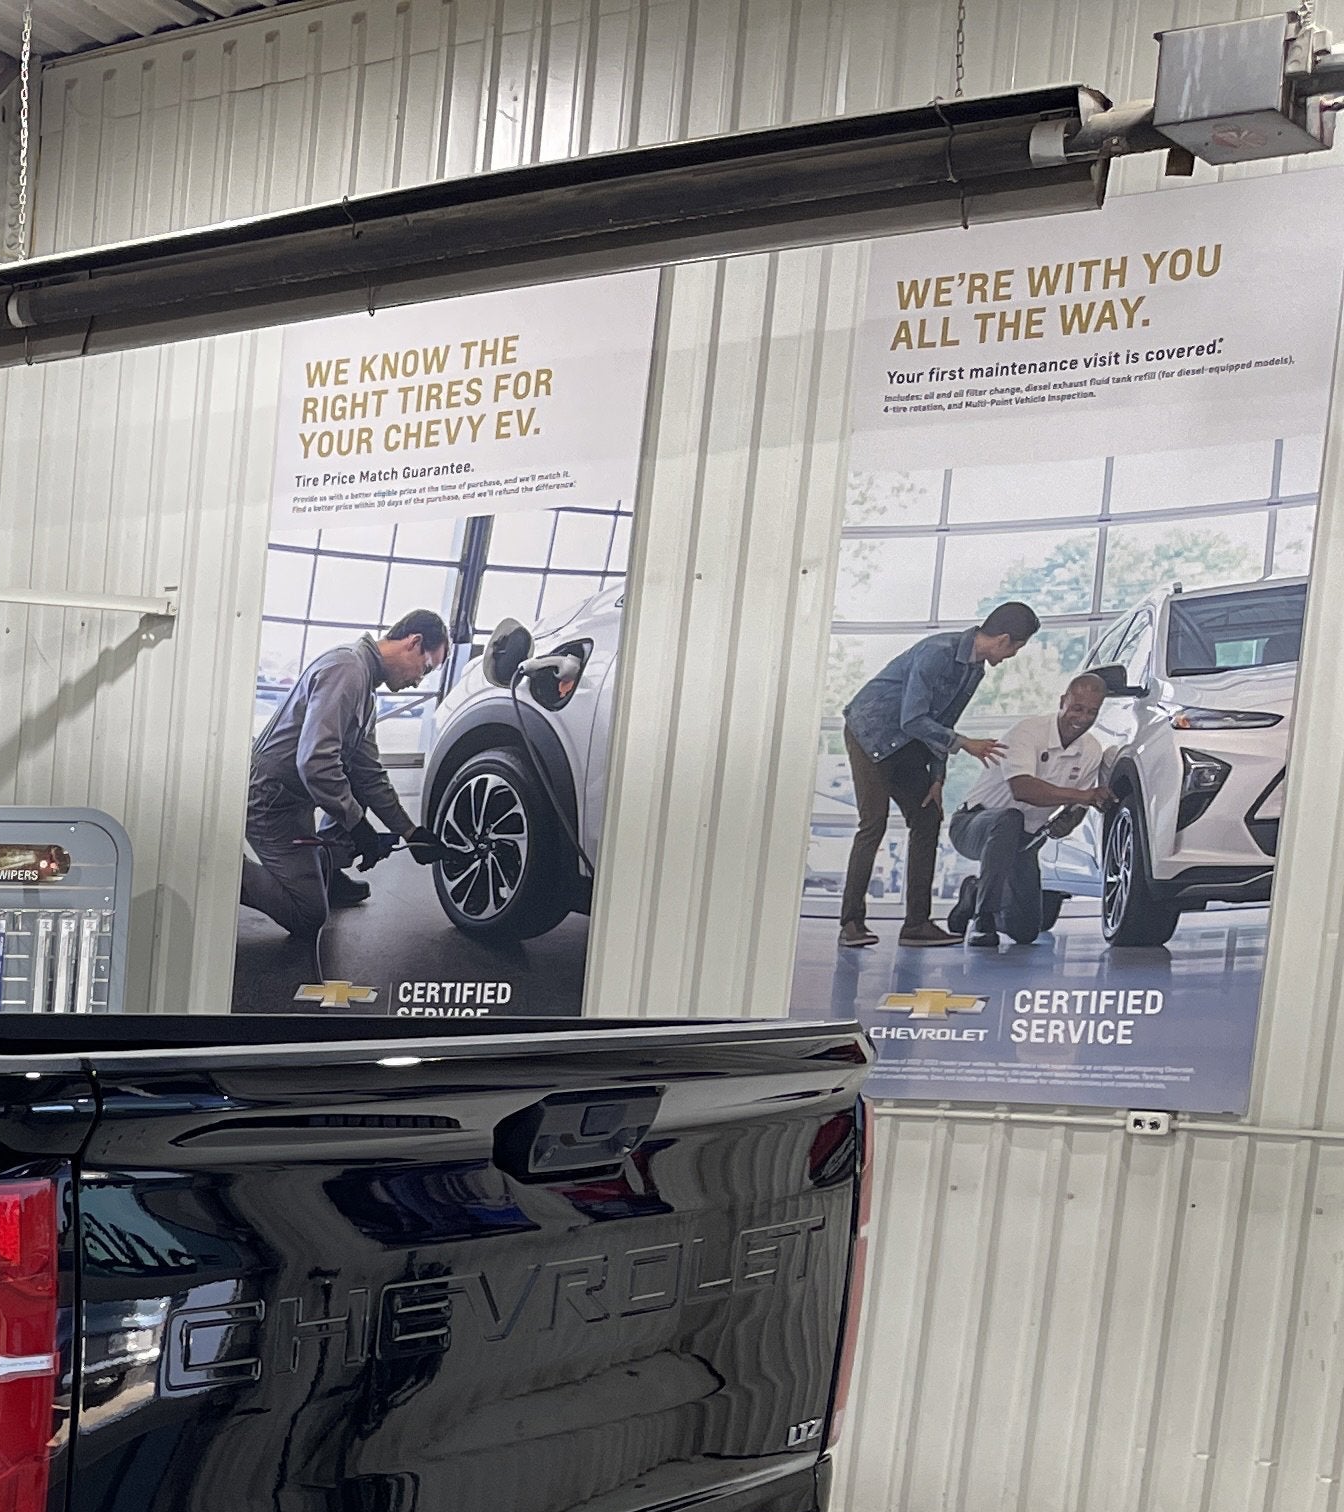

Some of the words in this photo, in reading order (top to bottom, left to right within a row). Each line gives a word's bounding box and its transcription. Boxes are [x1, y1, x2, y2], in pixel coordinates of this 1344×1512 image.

[1027, 256, 1127, 298] WITH
[1142, 244, 1222, 285] YOU
[890, 317, 960, 351] ALL
[974, 307, 1047, 343] THE
[1060, 296, 1151, 336] WAY.
[305, 358, 351, 388] WE
[359, 344, 451, 383] KNOW
[460, 335, 519, 370] THE
[887, 371, 924, 384] Your
[929, 367, 964, 382] first
[969, 357, 1078, 379] maintenance
[1084, 352, 1120, 368] visit
[1126, 351, 1139, 364] is
[937, 391, 952, 399] and
[989, 385, 1024, 396] change,
[1025, 382, 1051, 392] diesel
[1053, 379, 1088, 390] exhaust
[1090, 376, 1110, 386] fluid
[1112, 374, 1132, 383] tank
[1134, 372, 1156, 382] refill
[1158, 369, 1175, 380] (for
[1177, 360, 1253, 377] diesel-equipped
[301, 389, 389, 424] RIGHT
[398, 377, 483, 415] TIRES
[493, 368, 553, 403] FOR
[909, 402, 945, 413] rotation,
[947, 401, 963, 410] and
[965, 397, 1013, 409] Multi-Point
[1015, 395, 1045, 405] Vehicle
[298, 427, 374, 459] YOUR
[383, 413, 487, 451] CHEVY
[495, 407, 541, 440] EV.
[295, 475, 319, 488] Tire
[323, 473, 356, 486] Price
[359, 467, 398, 483] Match
[402, 462, 475, 480] Guarantee.
[328, 493, 344, 501] with
[350, 492, 372, 500] better
[399, 487, 416, 496] price
[440, 483, 457, 492] time
[458, 481, 466, 490] of
[503, 475, 518, 485] and
[537, 471, 561, 481] match
[313, 503, 334, 512] better
[335, 502, 353, 512] price
[387, 498, 403, 507] days
[413, 496, 425, 504] the
[462, 492, 475, 500] and
[494, 487, 520, 497] refund
[521, 485, 533, 493] the
[398, 981, 512, 1004] CERTIFIED
[1013, 990, 1164, 1015] CERTIFIED
[869, 1026, 989, 1042] CHEVROLET
[1010, 1019, 1134, 1045] SERVICE
[165, 1214, 826, 1396] CHEVROLET
[787, 1418, 823, 1447] LTZ
